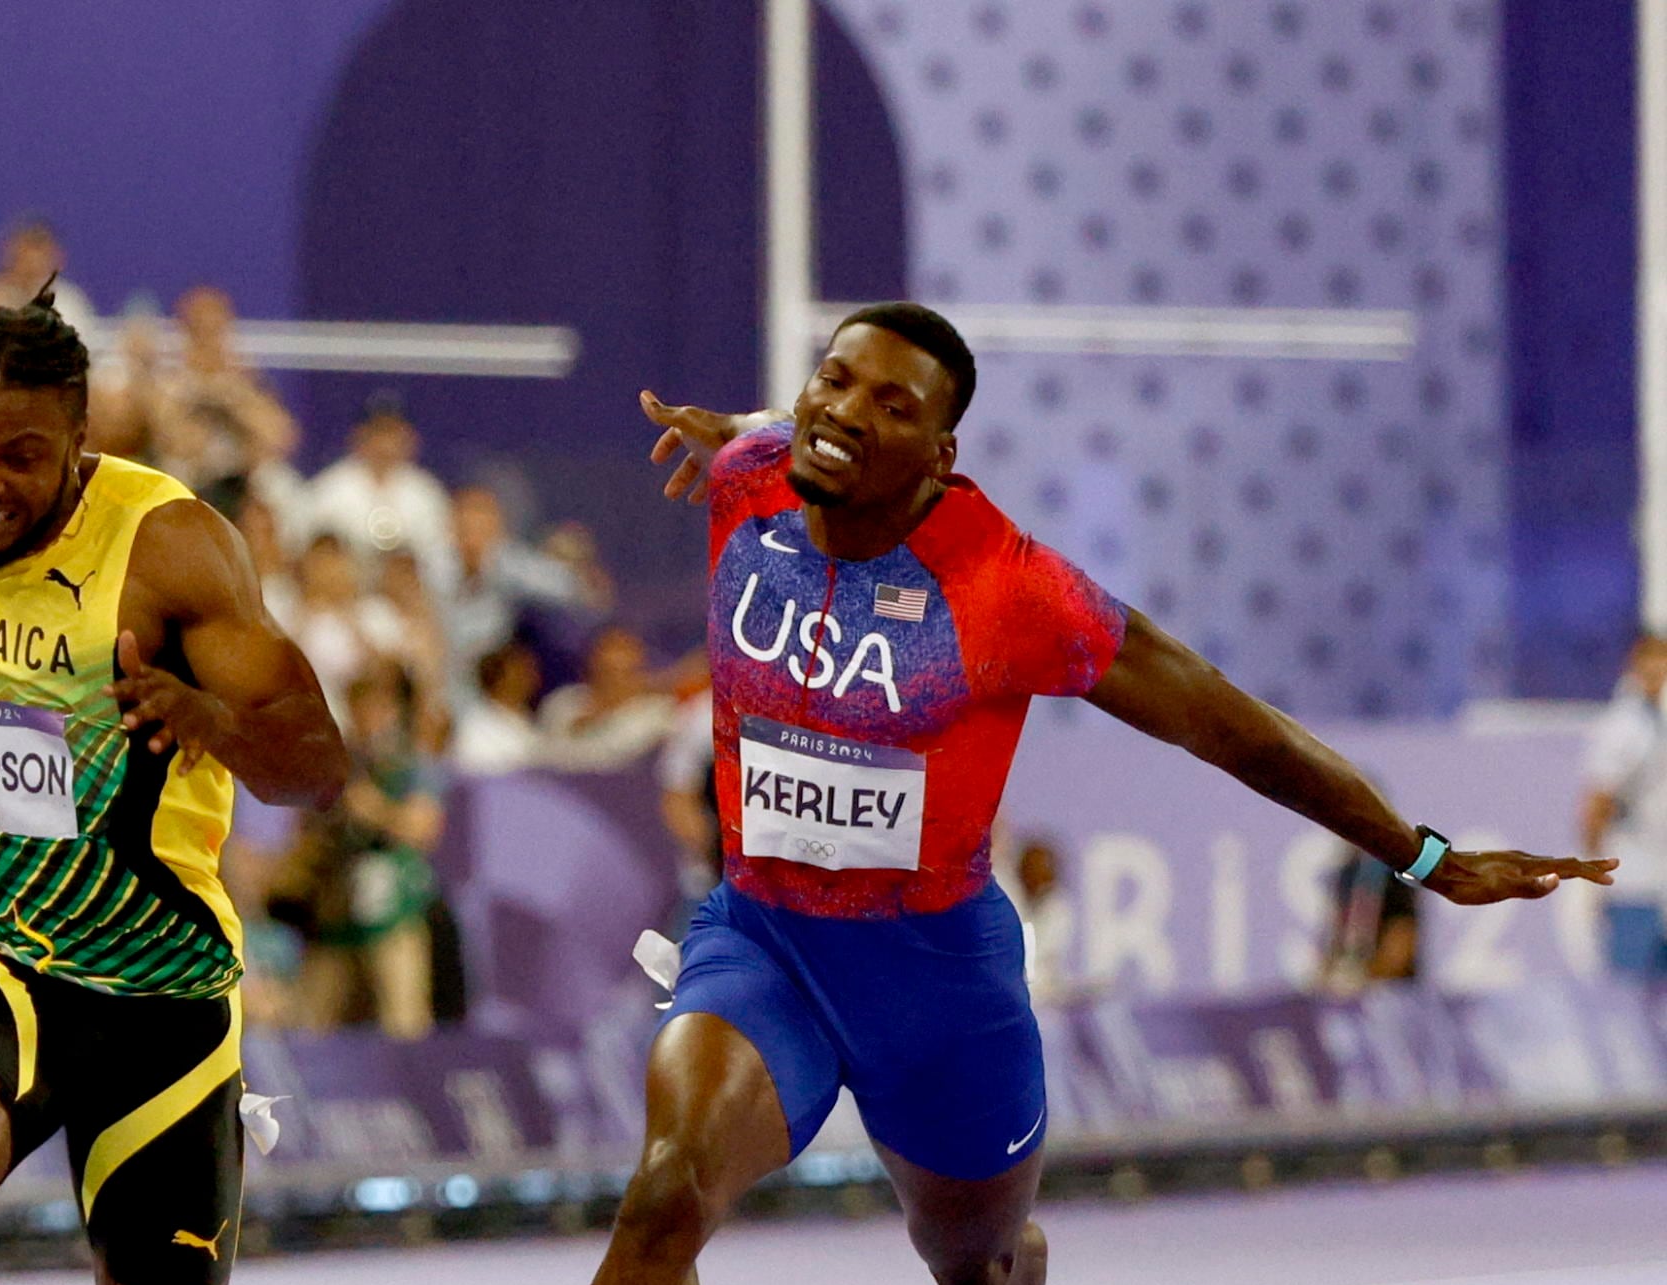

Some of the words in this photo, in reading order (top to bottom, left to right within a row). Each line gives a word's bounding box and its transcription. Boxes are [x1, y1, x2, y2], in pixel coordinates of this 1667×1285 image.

[731, 572, 902, 714] USA
[779, 729, 824, 753] PARIS
[827, 742, 874, 762] 2024
[742, 764, 908, 831] KERLEY
